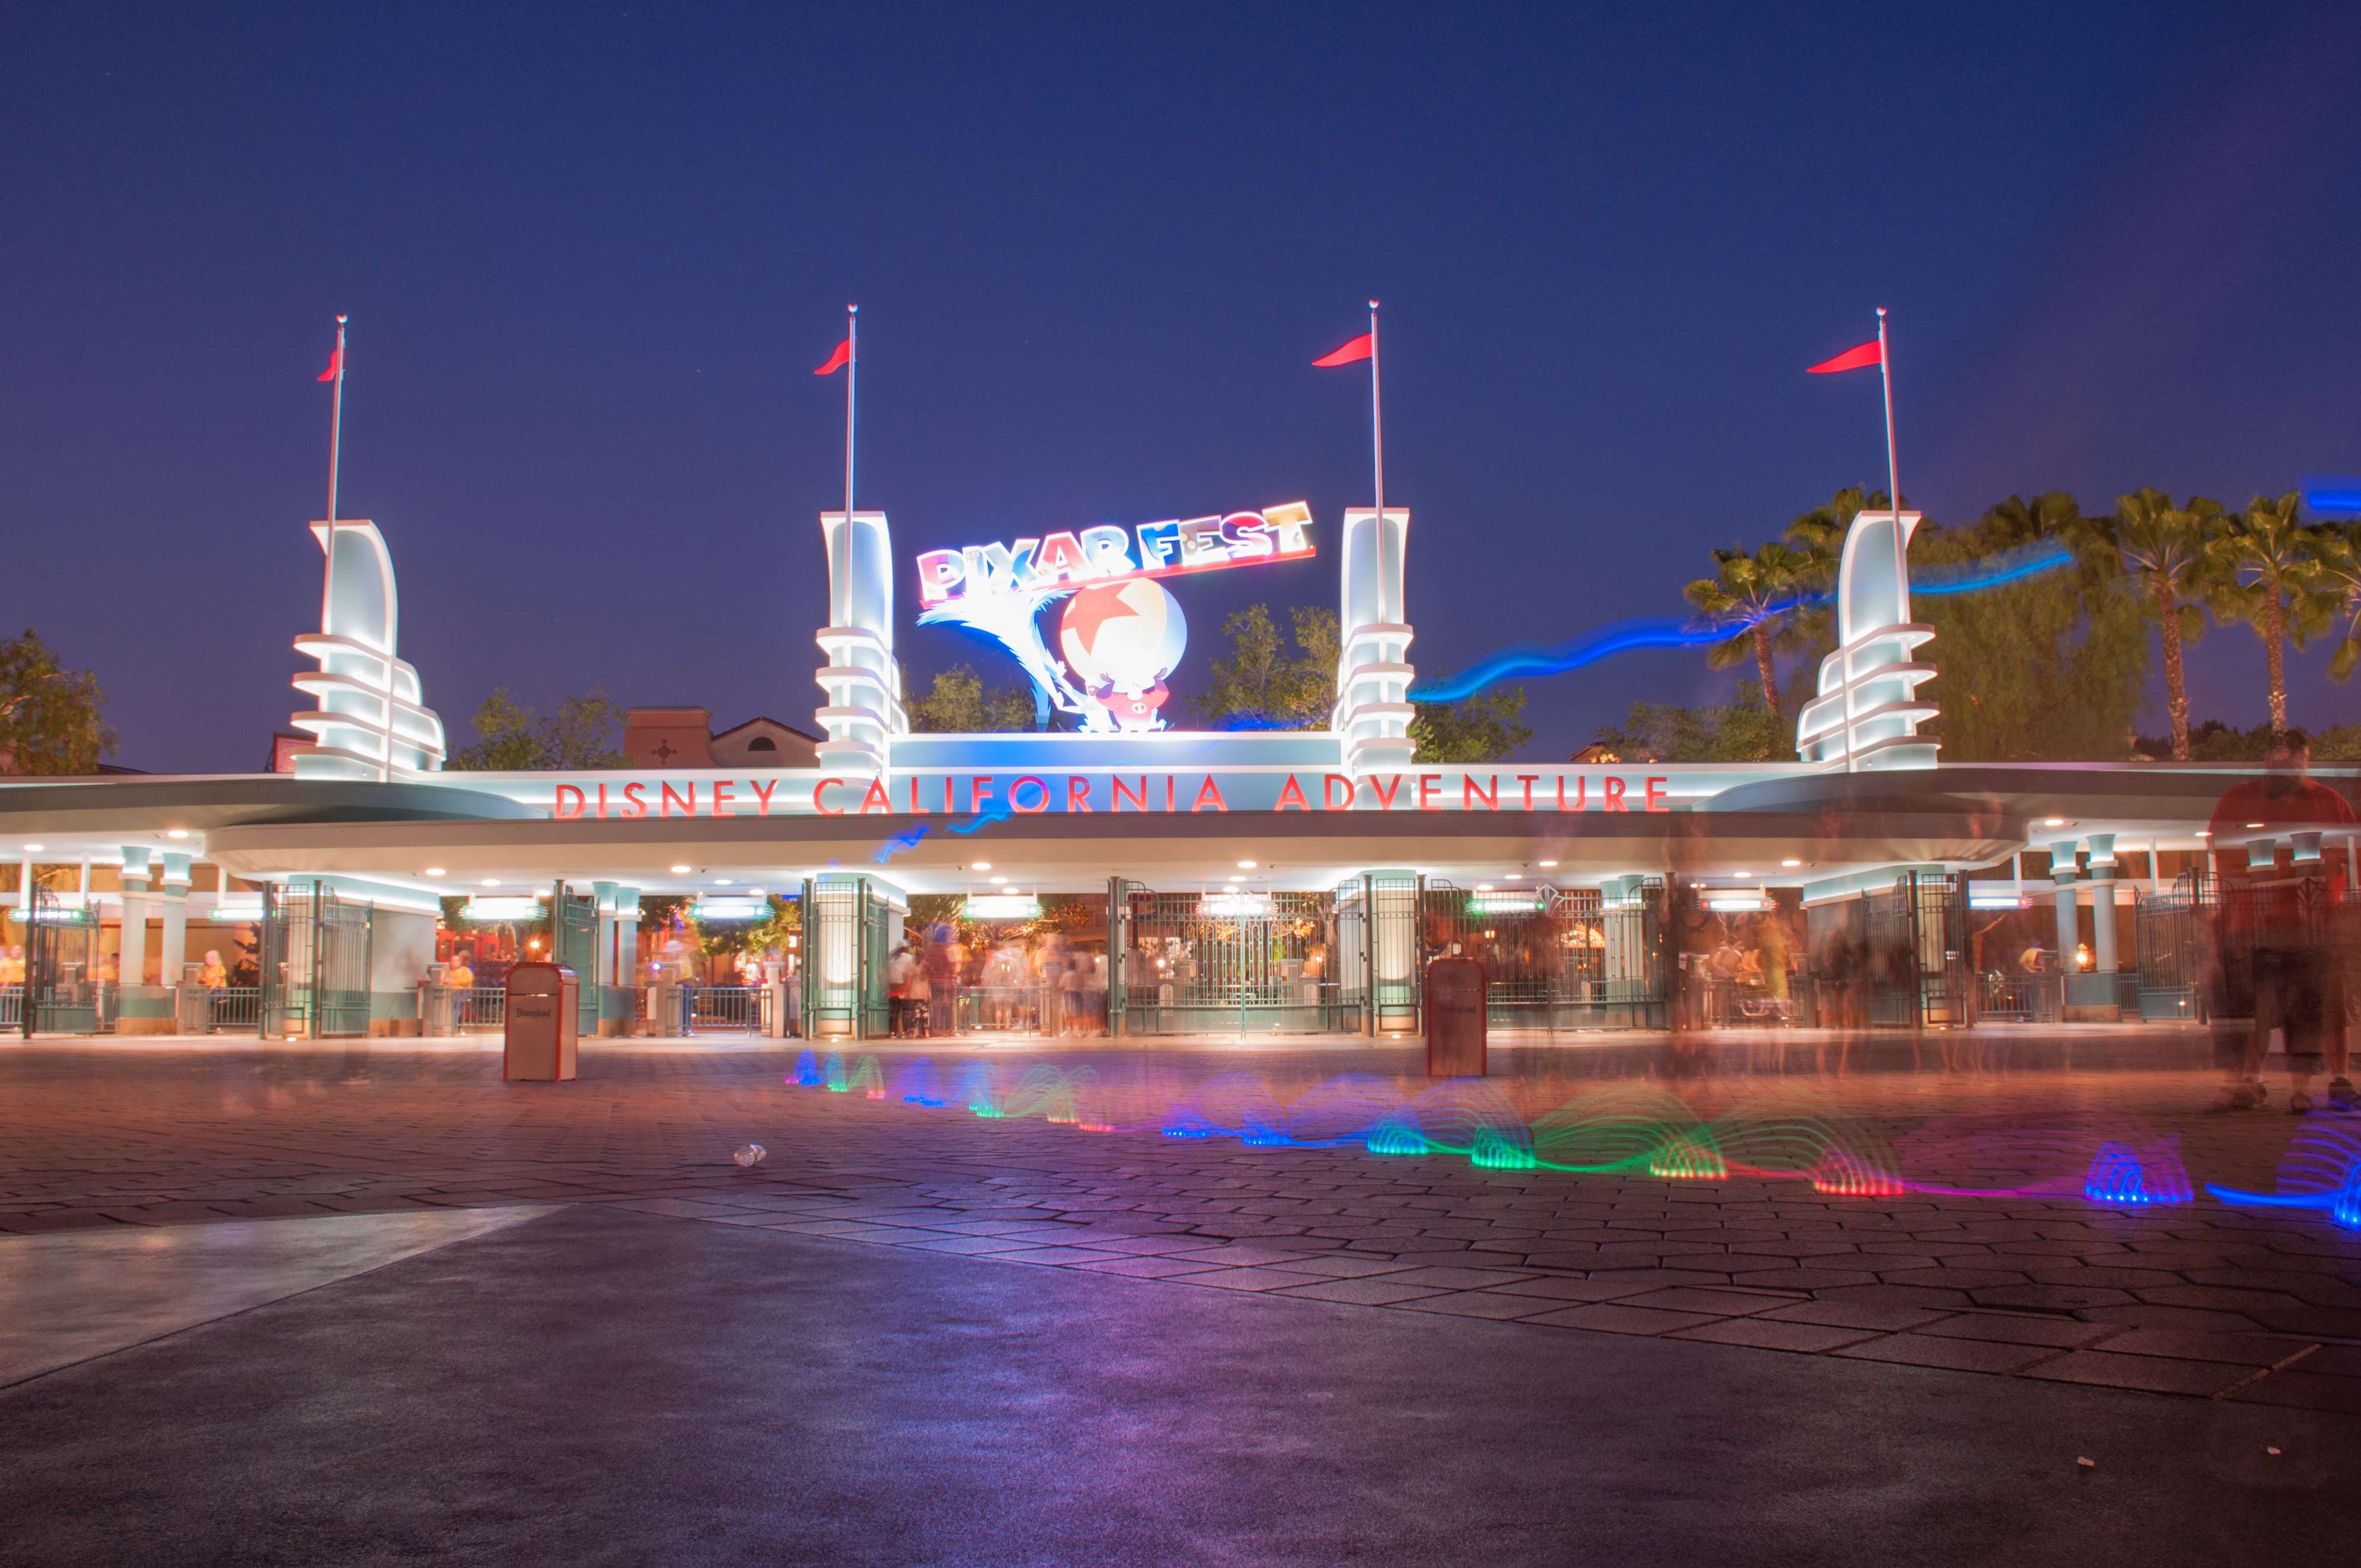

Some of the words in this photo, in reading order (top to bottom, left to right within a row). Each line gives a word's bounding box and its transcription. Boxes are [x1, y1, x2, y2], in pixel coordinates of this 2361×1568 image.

[917, 525, 1137, 601] PIXAR
[1136, 500, 1313, 571] FEST
[554, 779, 779, 820] DISNEY
[812, 774, 1229, 815] CALIFORNIA
[1274, 772, 1670, 812] ADVENTURE
